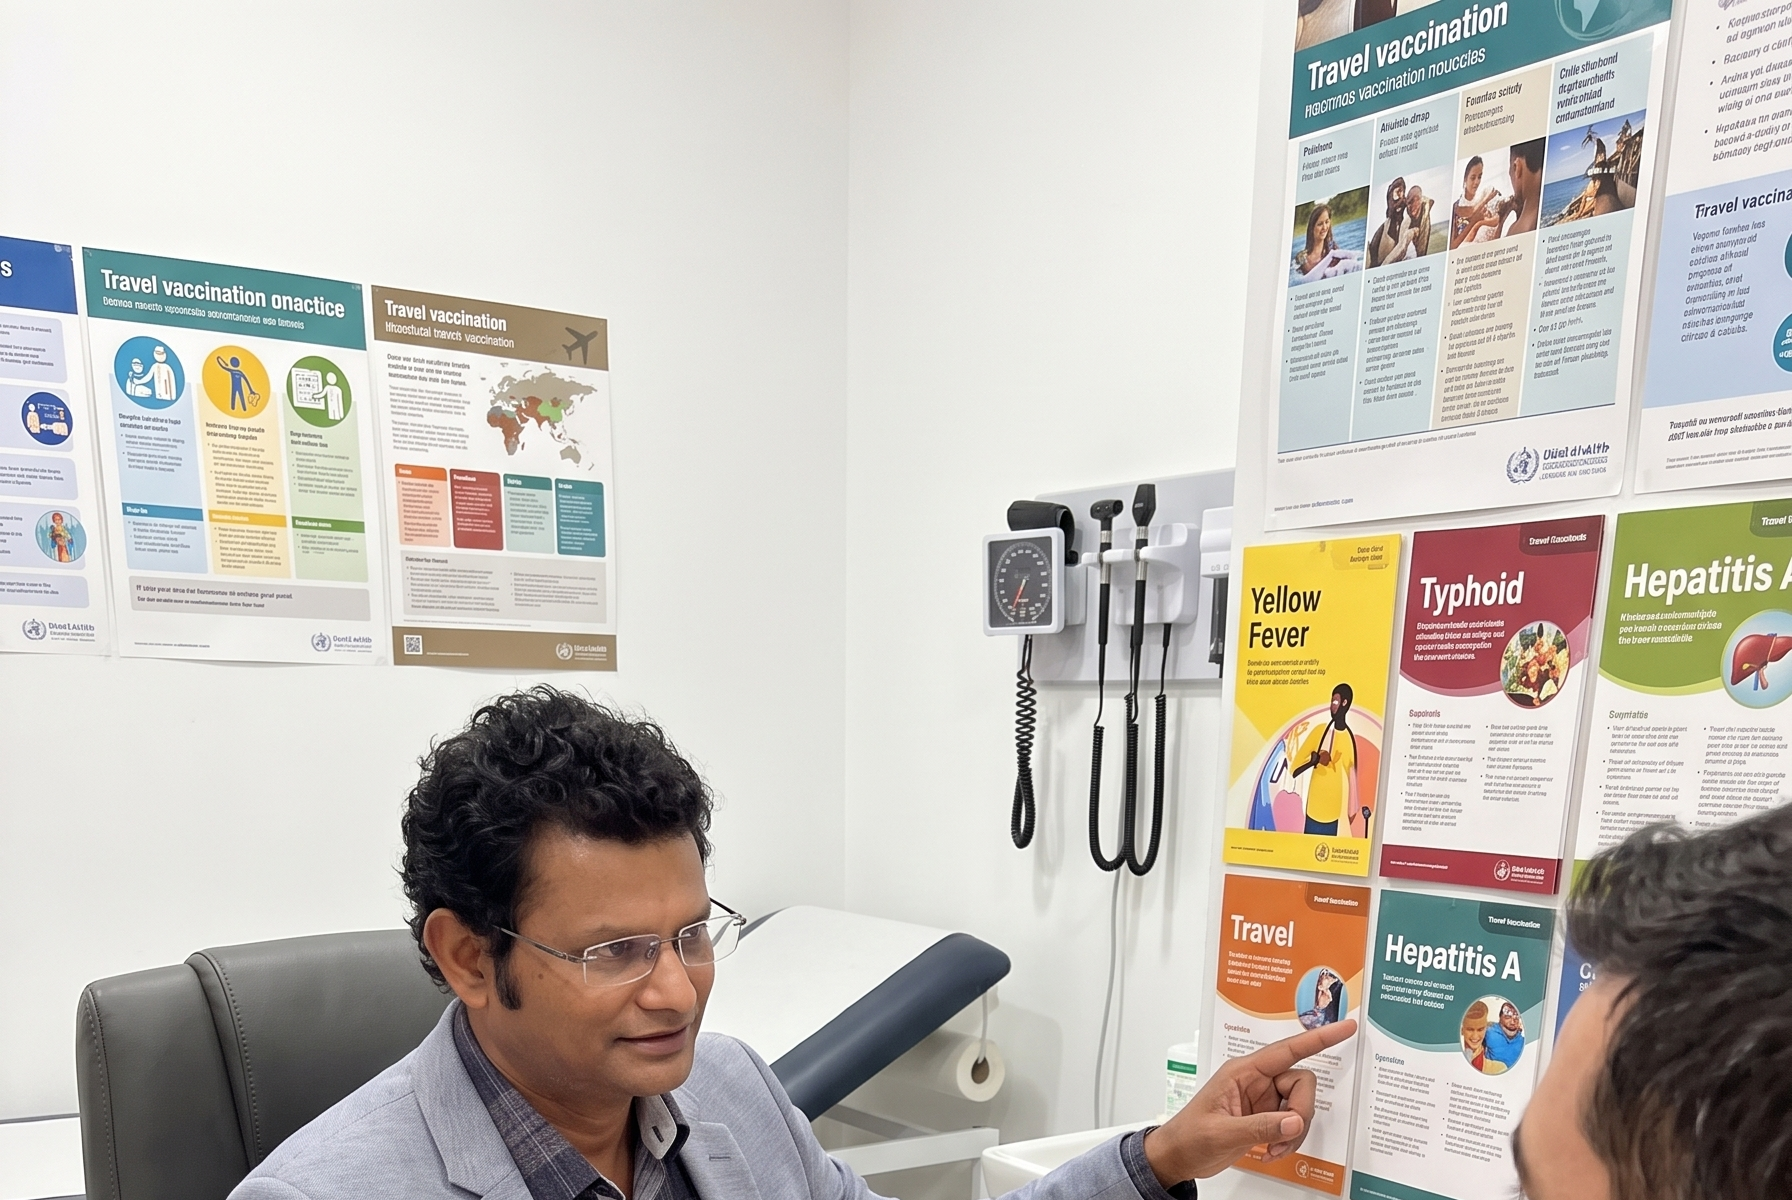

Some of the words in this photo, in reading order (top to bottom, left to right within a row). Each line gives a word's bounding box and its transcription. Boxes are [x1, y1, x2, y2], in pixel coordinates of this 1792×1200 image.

[1308, 43, 1370, 91] Travel
[1375, 1, 1508, 68] vaccination
[1358, 66, 1425, 101] vaccination
[100, 268, 158, 295] Travel
[162, 279, 267, 308] vaccination
[271, 294, 346, 319] onactice
[385, 299, 427, 321] Travel
[429, 309, 507, 332] vaccination
[464, 333, 515, 349] vaccination
[1761, 515, 1787, 526] Travel
[1420, 571, 1525, 617] Typhoid
[1624, 554, 1773, 606] Hepatitis
[1250, 584, 1322, 614] Yellow
[1249, 621, 1310, 649] Fever
[1230, 914, 1295, 948] Travel
[1384, 933, 1497, 978] Hepatitis
[1500, 951, 1522, 982] A
